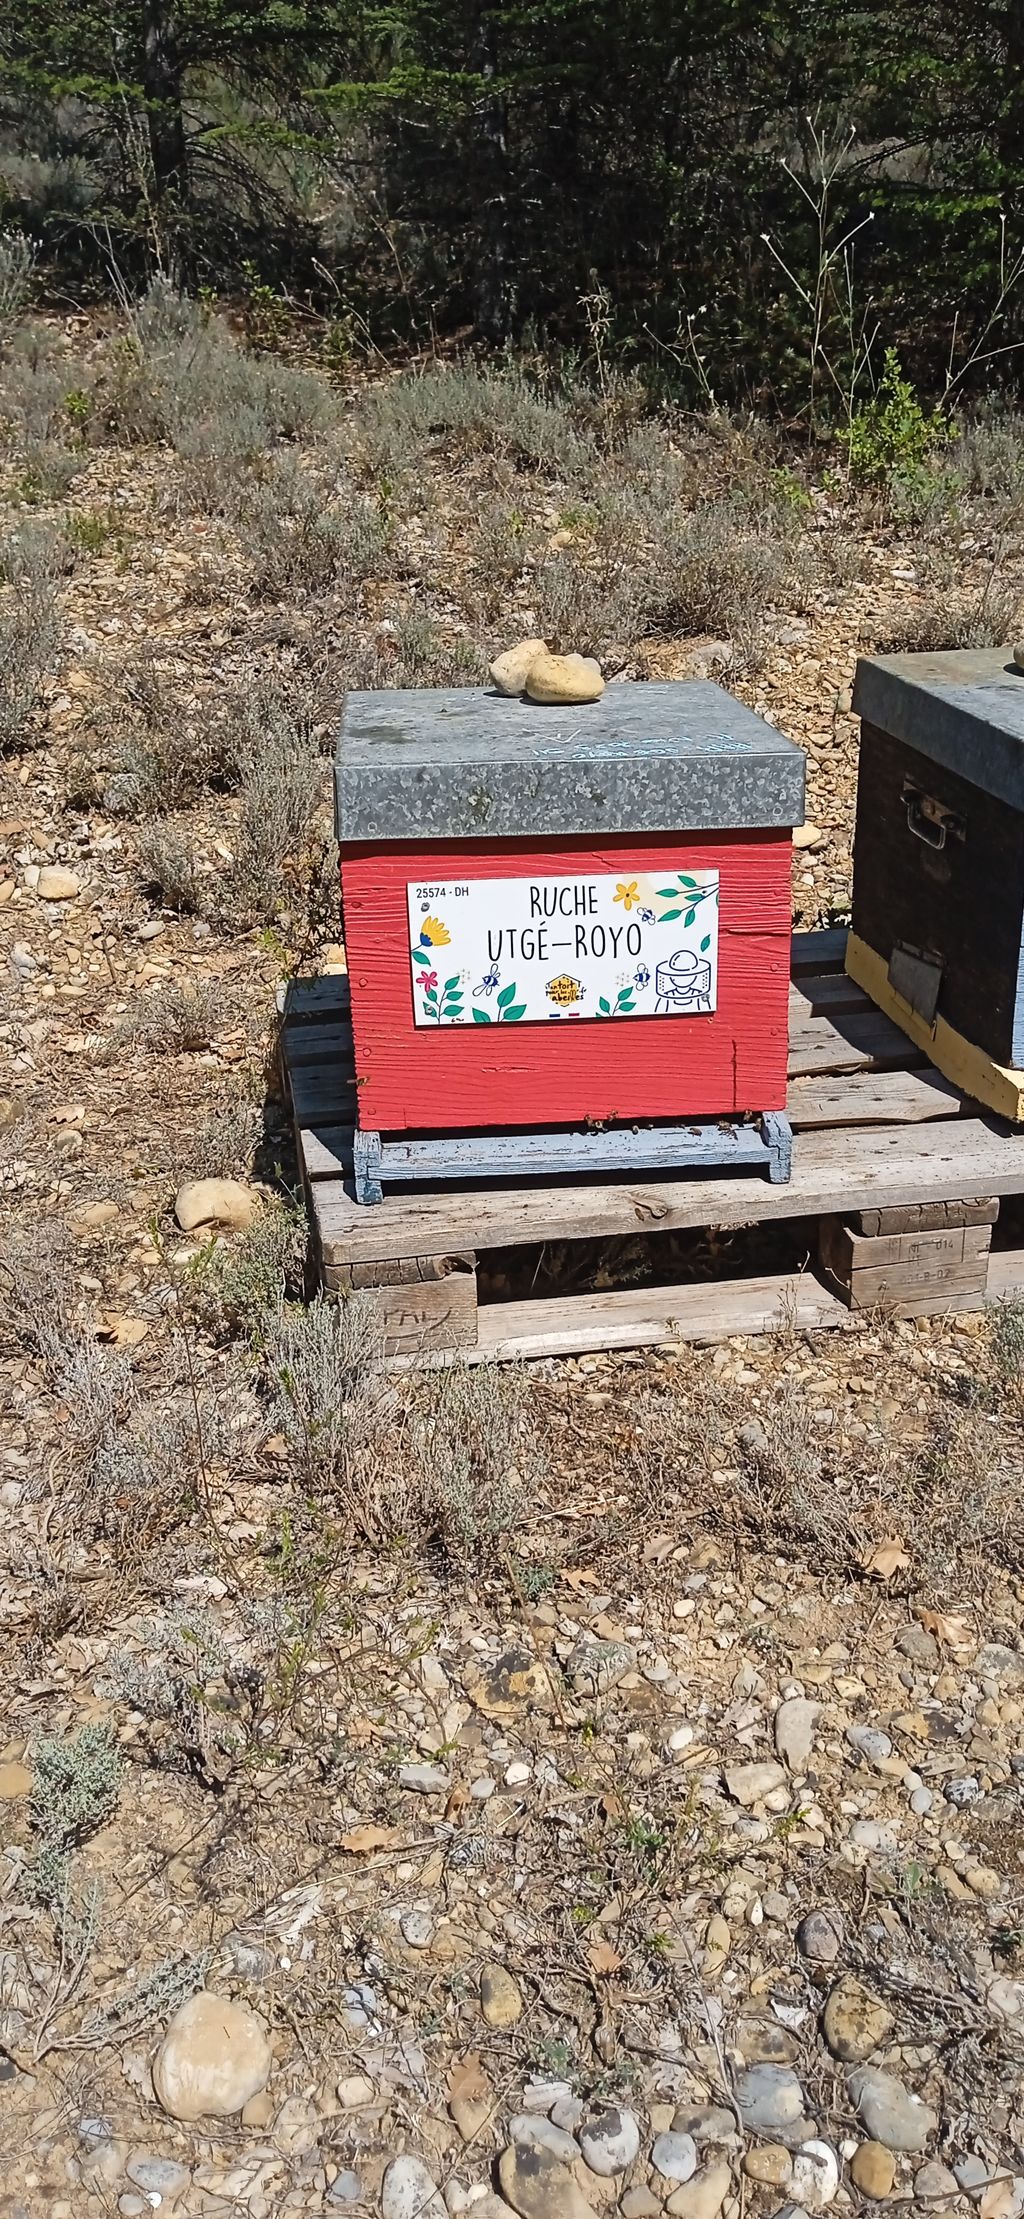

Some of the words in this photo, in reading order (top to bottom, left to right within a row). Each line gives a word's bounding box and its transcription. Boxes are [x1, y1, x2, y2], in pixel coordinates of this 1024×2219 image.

[416, 887, 446, 899] 25574
[454, 886, 469, 897] DH
[530, 885, 598, 918] RUCHE
